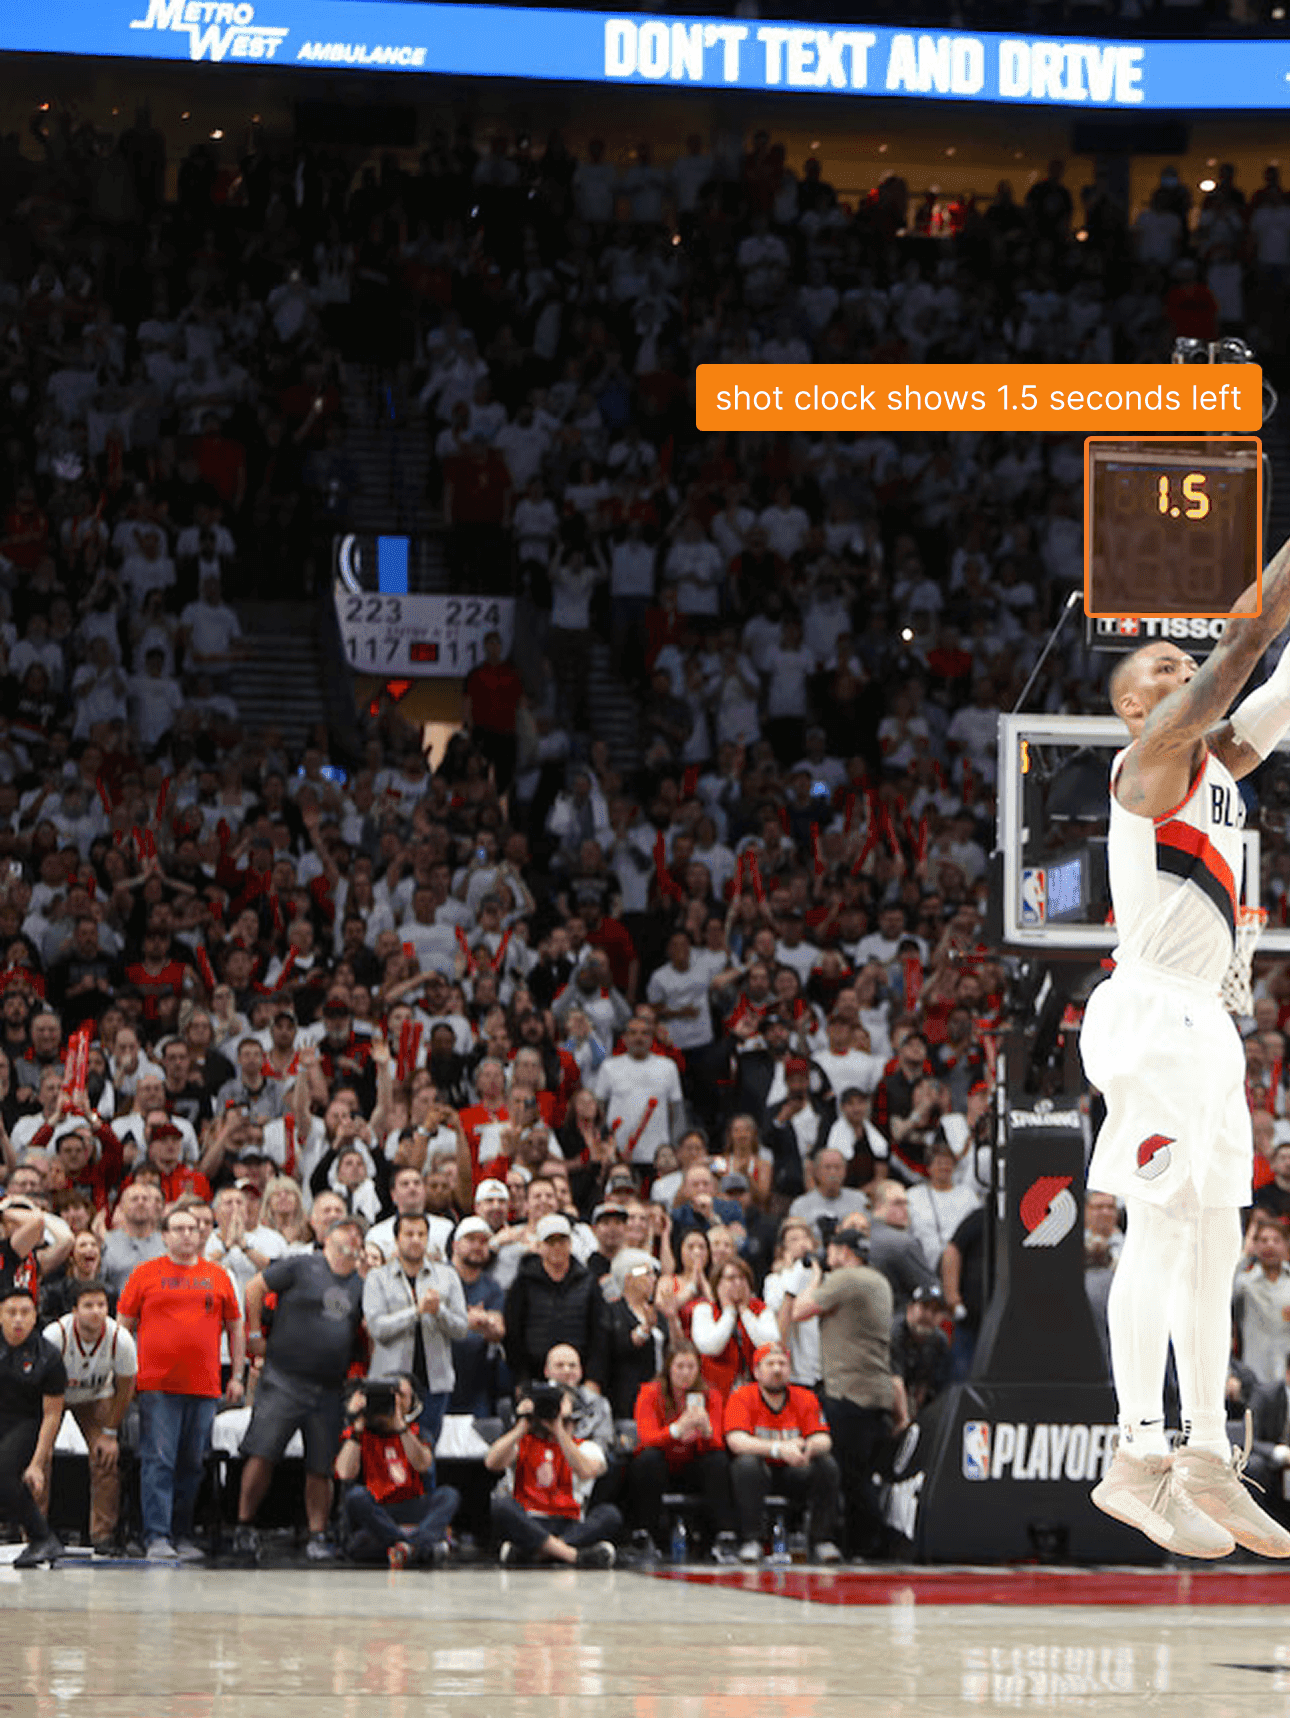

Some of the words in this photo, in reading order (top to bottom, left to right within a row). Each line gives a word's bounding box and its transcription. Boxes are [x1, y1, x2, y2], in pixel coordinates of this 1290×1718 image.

[297, 42, 427, 66] AMBULANCE
[604, 19, 748, 82] DON'T
[757, 28, 876, 89] TEXT
[885, 34, 984, 94] AND
[999, 40, 1145, 104] DRIVE
[1157, 473, 1211, 520] 1.5
[346, 598, 402, 624] 223
[446, 600, 501, 626] 224
[1140, 618, 1227, 639] TISSO
[346, 636, 401, 663] 117
[446, 640, 479, 667] 11
[991, 1422, 1121, 1482] PLAYOFF
